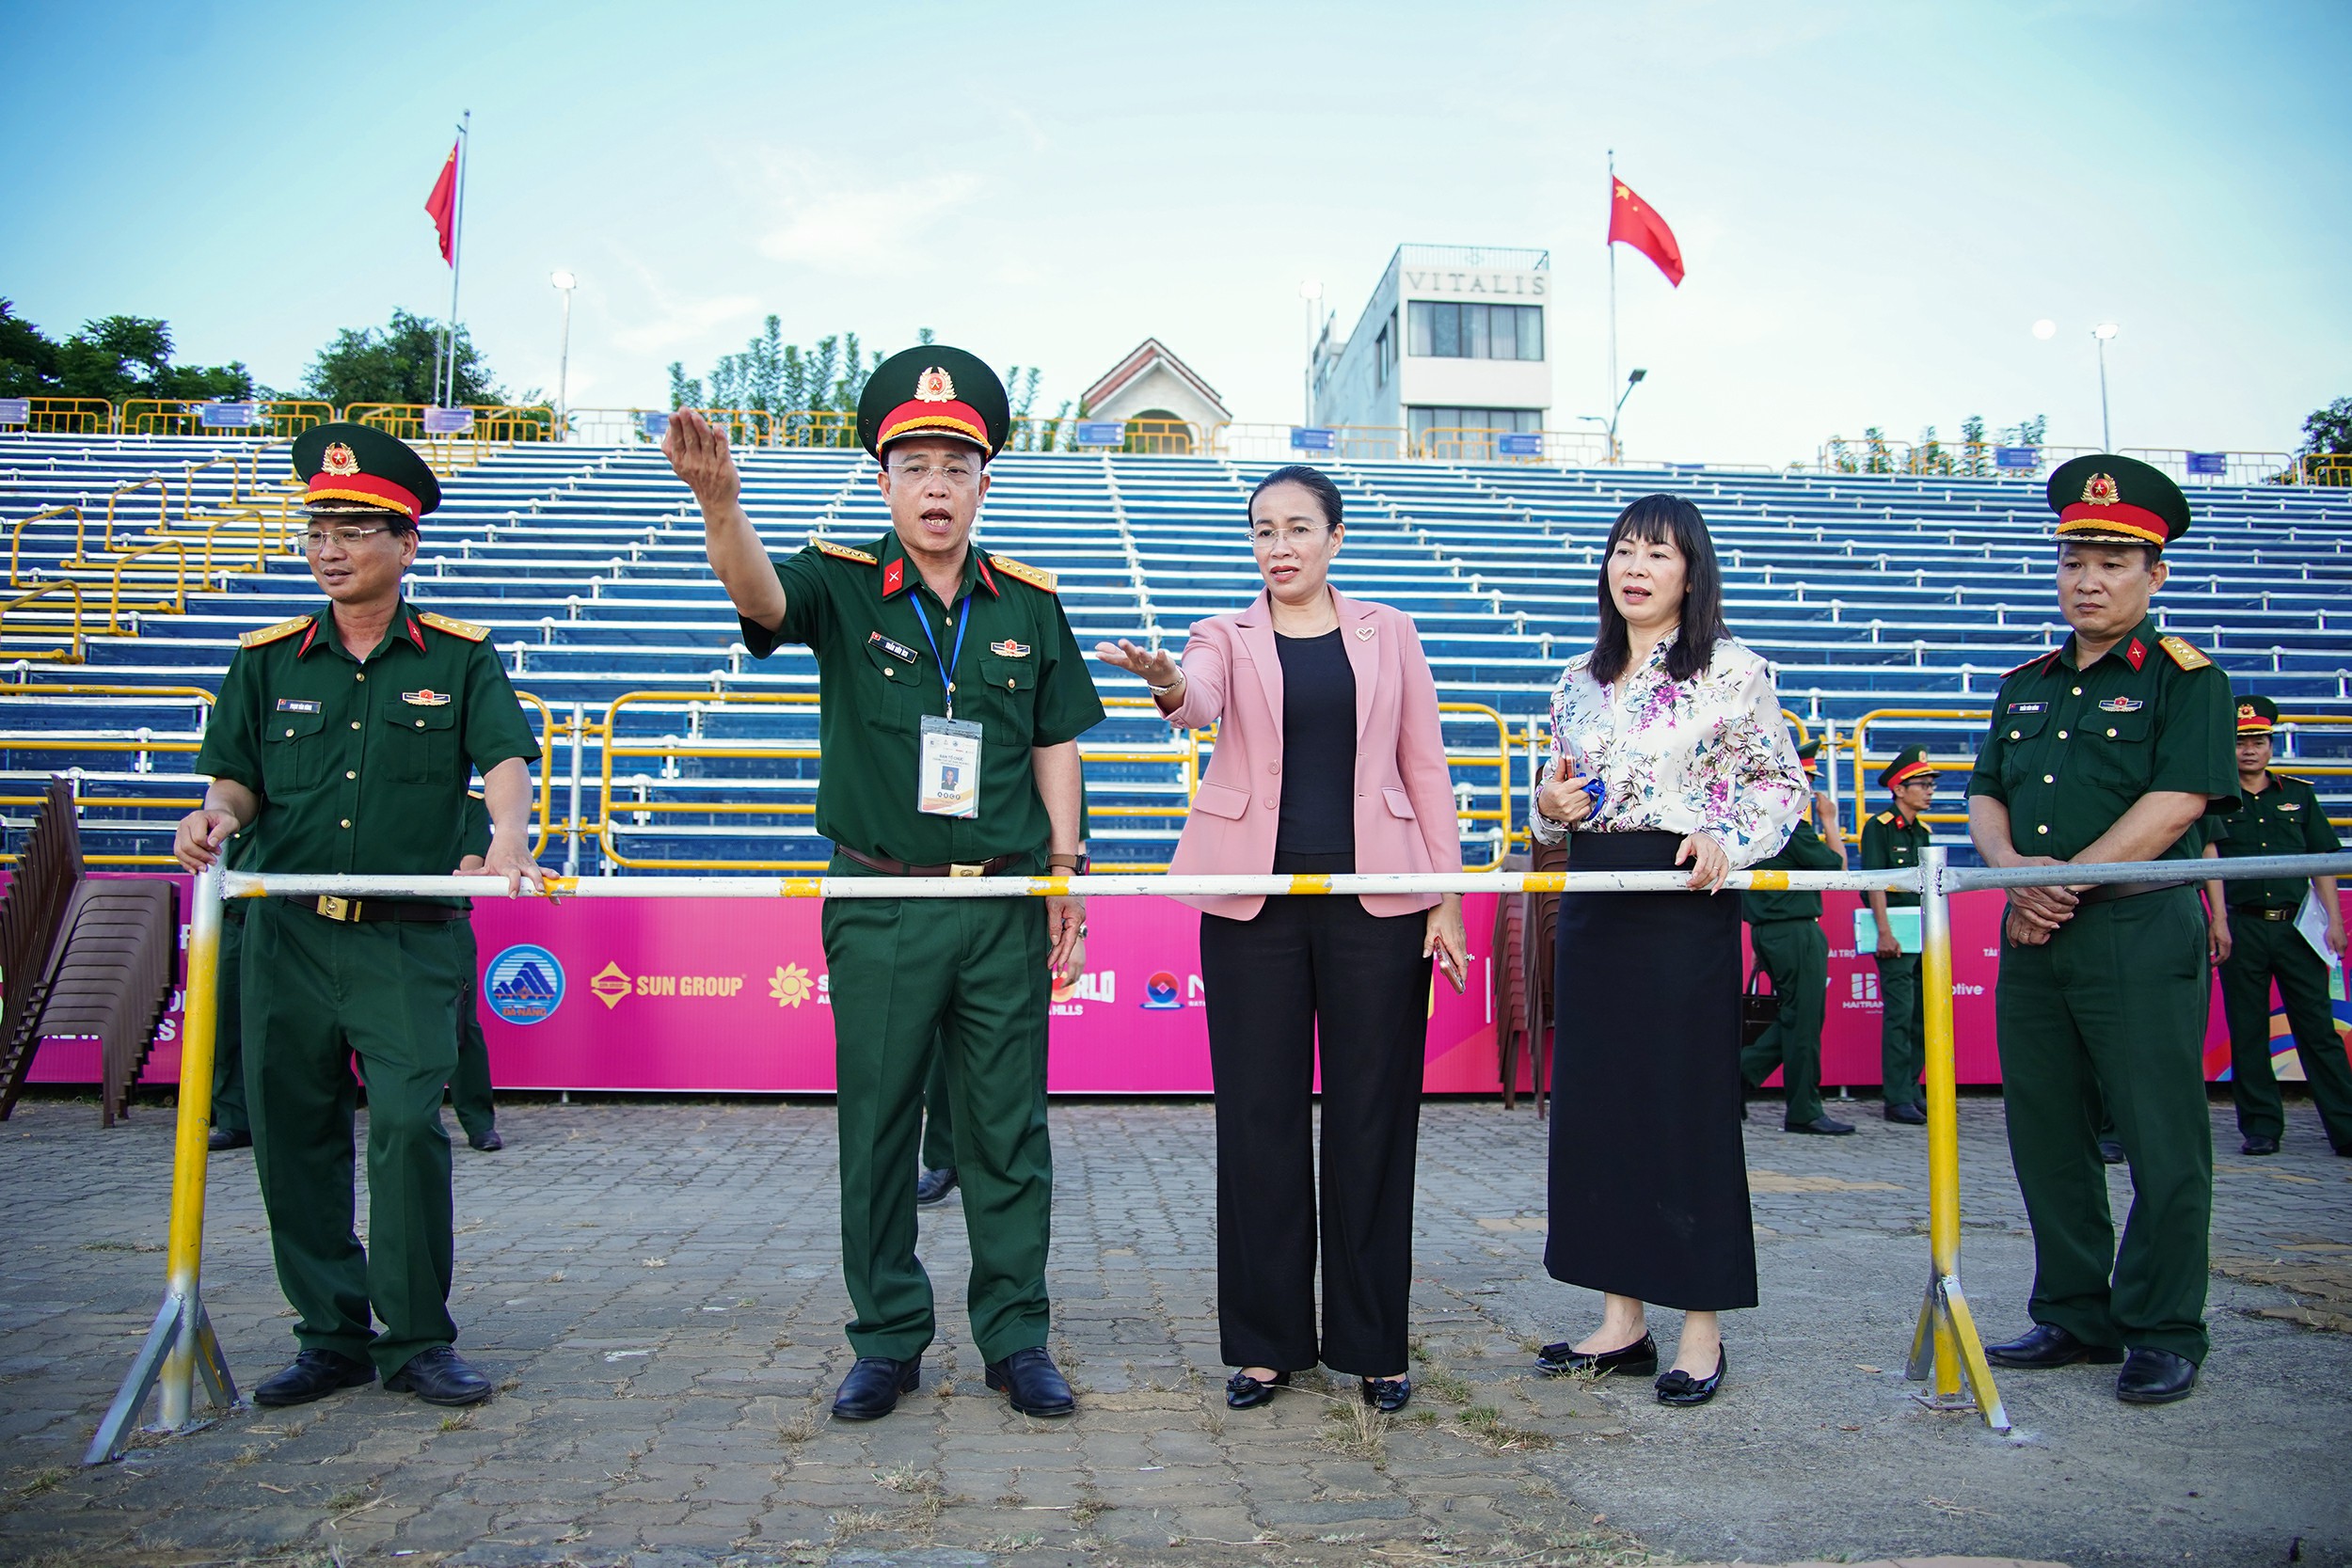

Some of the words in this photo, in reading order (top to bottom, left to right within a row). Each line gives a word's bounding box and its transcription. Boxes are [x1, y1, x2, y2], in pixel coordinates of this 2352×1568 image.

[1406, 271, 1546, 295] VITALIS
[636, 975, 675, 996] SUN
[679, 976, 743, 997] GROUP
[1052, 1005, 1084, 1016] HILLS
